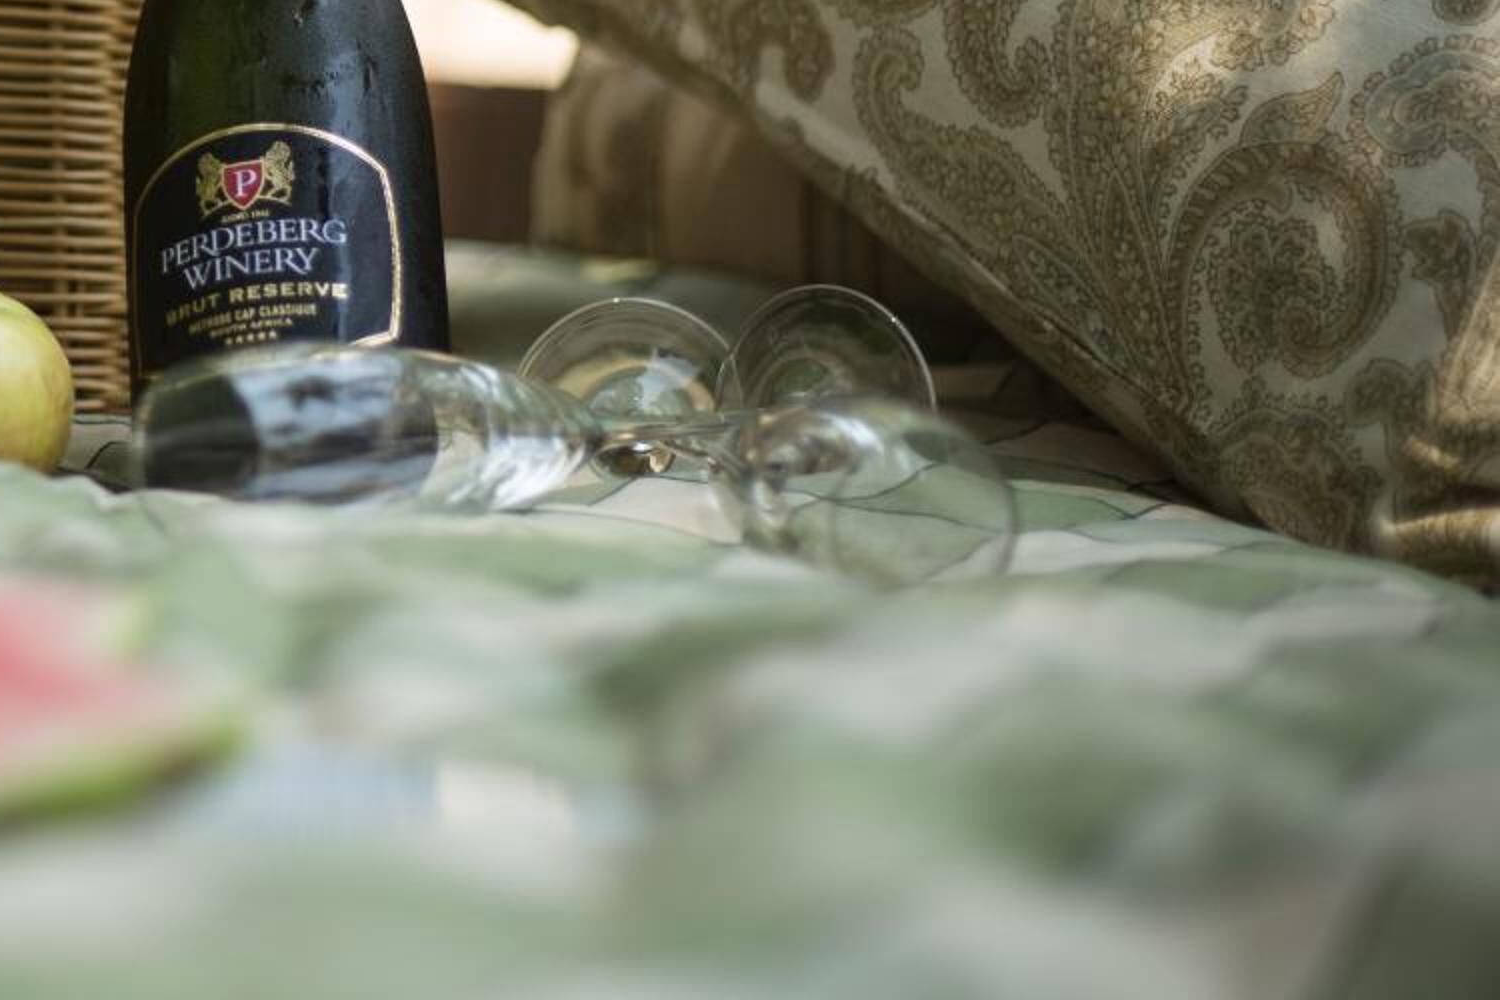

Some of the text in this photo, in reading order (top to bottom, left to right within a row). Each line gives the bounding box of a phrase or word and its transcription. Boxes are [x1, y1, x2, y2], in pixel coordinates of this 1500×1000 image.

[235, 169, 258, 198] P
[162, 217, 348, 274] PERDEBERG
[183, 247, 319, 291] WINERY
[229, 283, 349, 303] RESERVE
